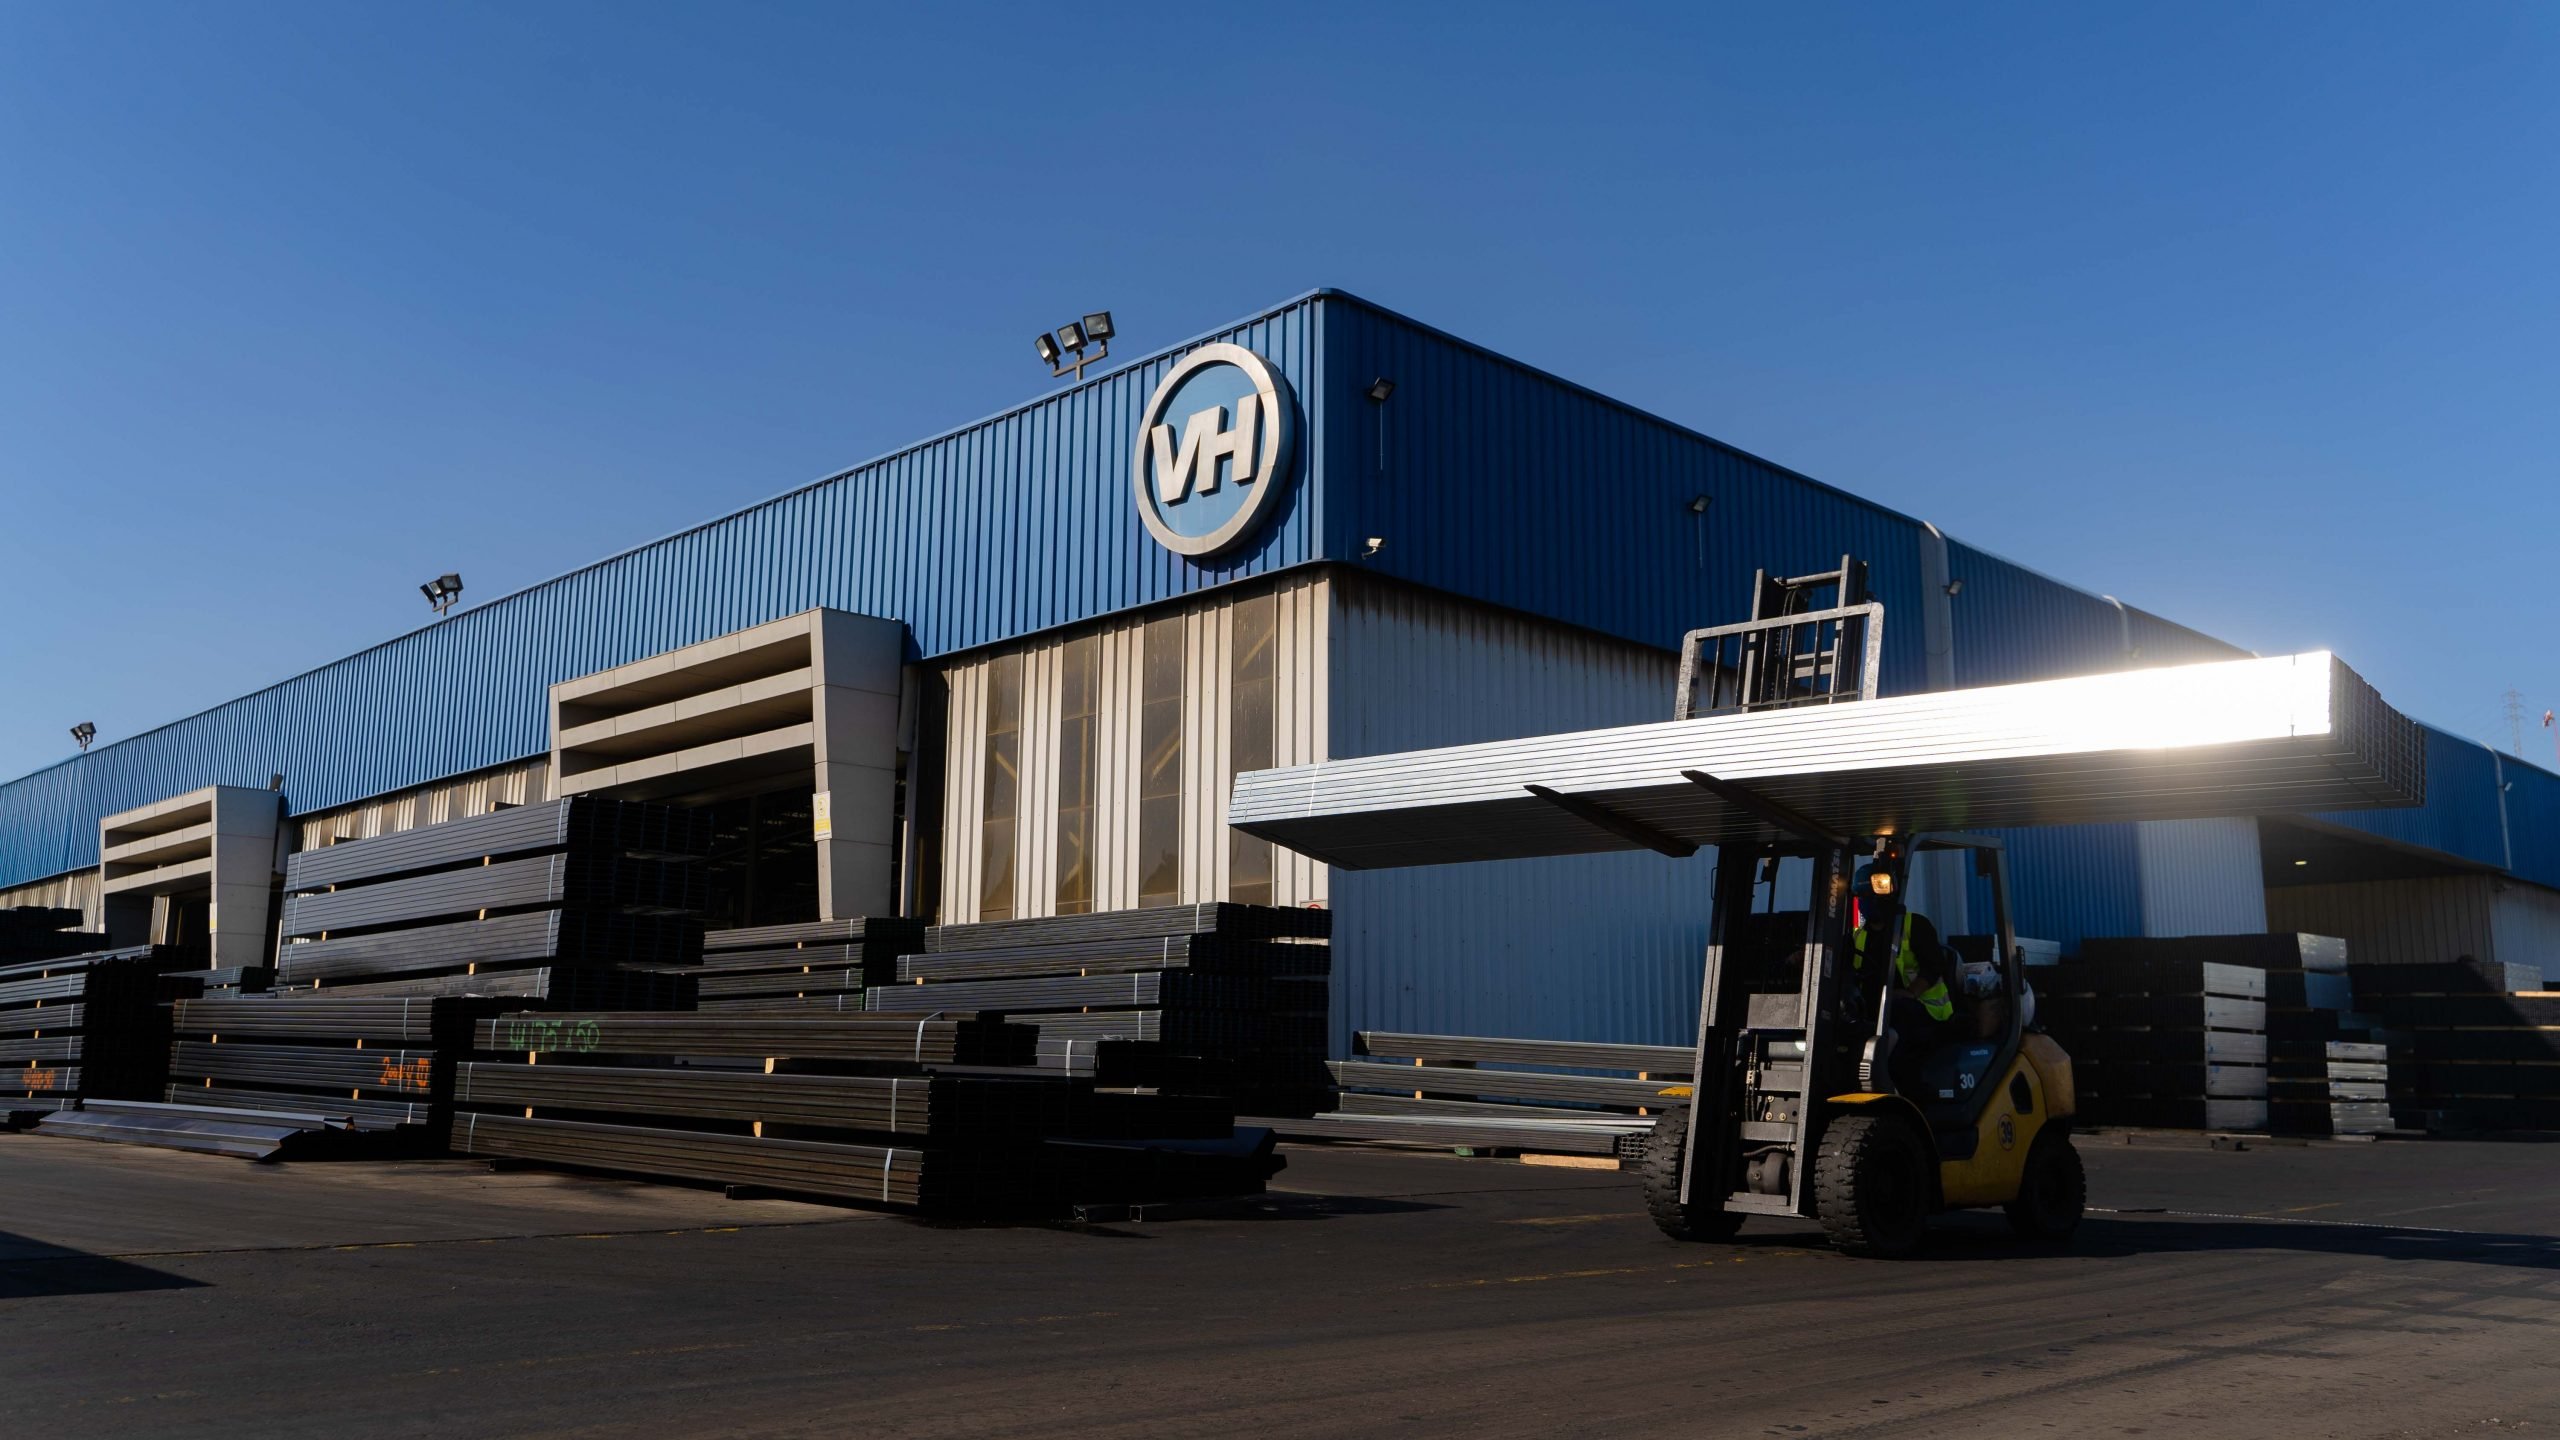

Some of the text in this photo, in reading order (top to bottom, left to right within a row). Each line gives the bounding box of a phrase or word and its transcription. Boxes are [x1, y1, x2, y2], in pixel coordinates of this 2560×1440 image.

[1151, 392, 1263, 506] VH
[1828, 848, 1841, 918] KOMATSU
[1959, 1072, 1975, 1089] 30
[2000, 1120, 2013, 1144] 39
